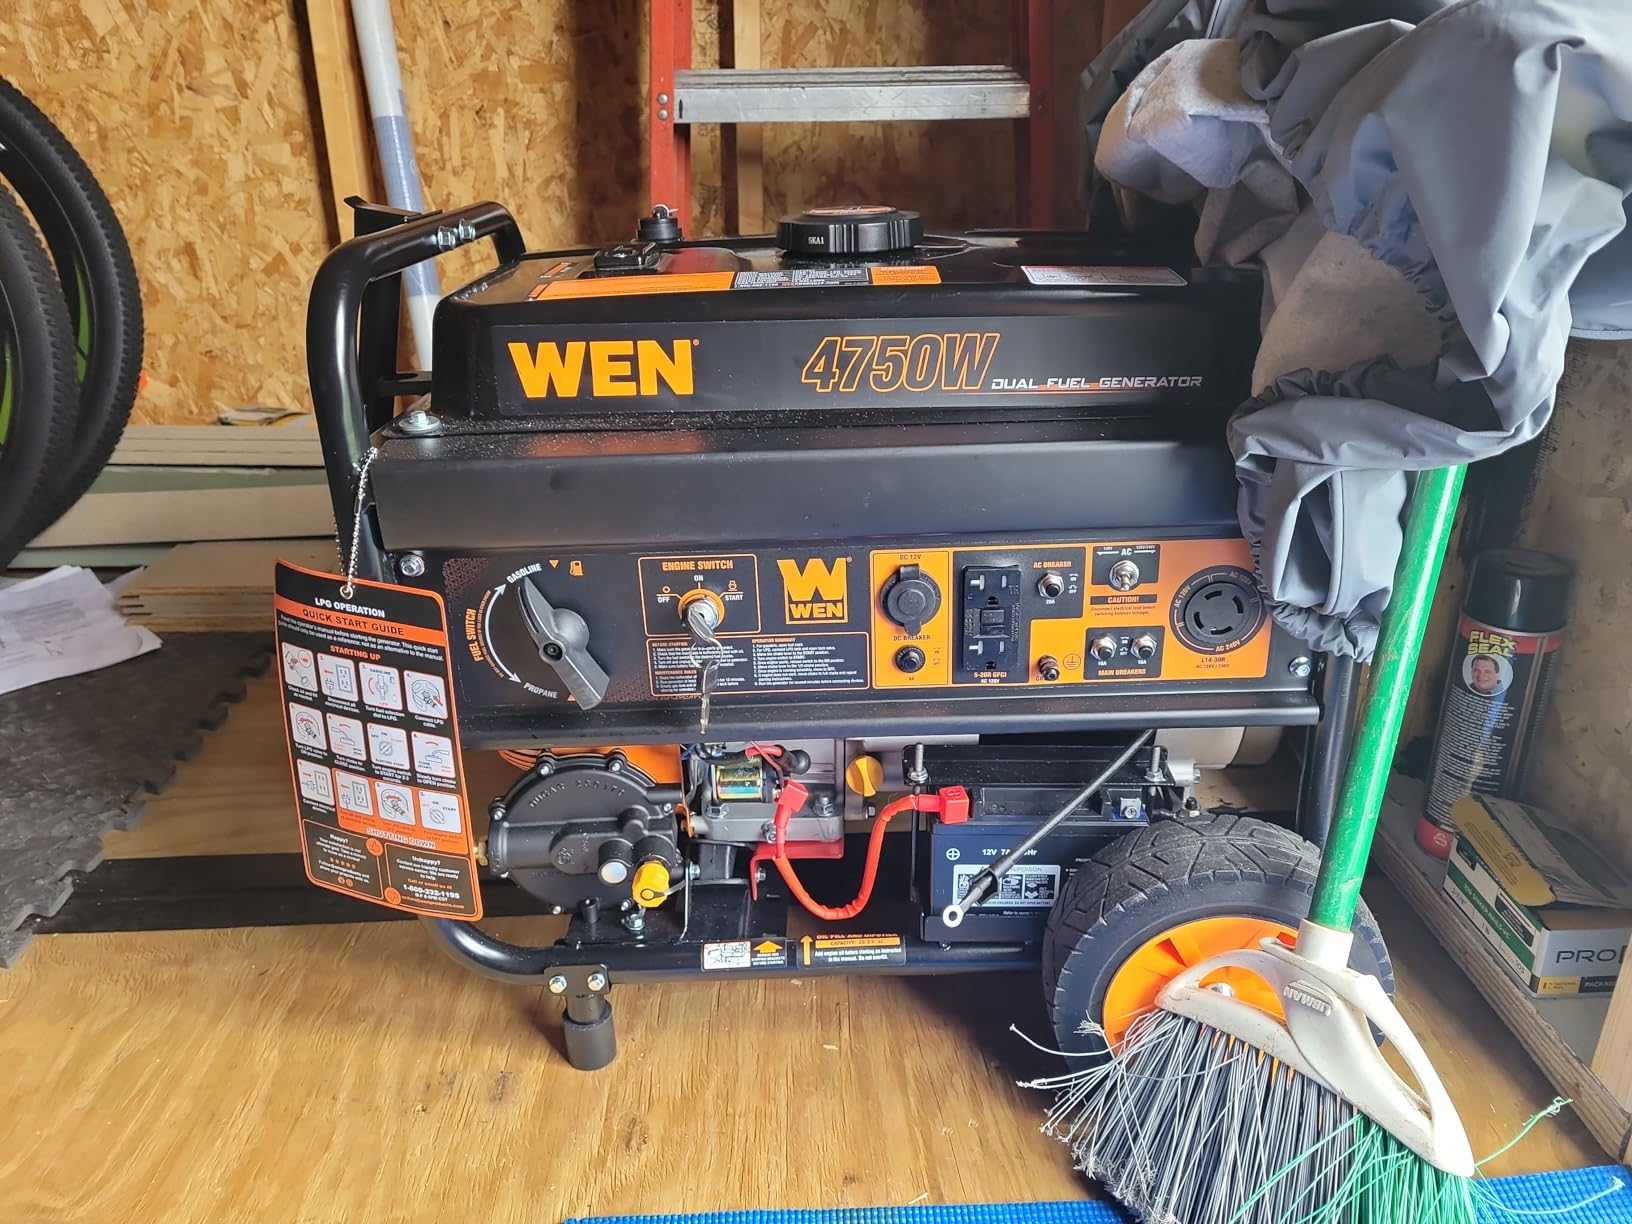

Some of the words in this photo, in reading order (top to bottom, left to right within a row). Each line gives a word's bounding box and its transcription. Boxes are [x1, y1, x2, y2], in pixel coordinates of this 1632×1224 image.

[508, 340, 694, 398] WEN
[801, 333, 999, 393] 4750W
[992, 378, 1038, 390] DUAL
[1047, 378, 1090, 389] FUEL
[1100, 376, 1202, 388] GENERATOR
[506, 562, 543, 584] GASOLINE
[662, 561, 696, 571] ENGINE
[698, 560, 734, 570] SWITCH
[1174, 600, 1181, 608] AC
[1180, 585, 1191, 599] 120V
[315, 598, 333, 608] LPG
[334, 602, 385, 618] OPERATION
[790, 602, 844, 618] WEN
[303, 609, 333, 623] QUICK
[336, 617, 368, 629] START
[372, 623, 405, 636] GUIDE
[465, 608, 477, 640] SWITCH
[1225, 640, 1240, 650] 240V
[1467, 642, 1513, 658] SEAL
[1469, 630, 1518, 650] FLEX
[330, 645, 368, 659] STARTING
[370, 652, 381, 661] UP
[469, 640, 484, 662] FUEL
[524, 682, 558, 699] PROPANE
[367, 829, 408, 843] SHUTTING
[410, 838, 435, 848] DOWN
[1283, 986, 1332, 1016] LIBMAN
